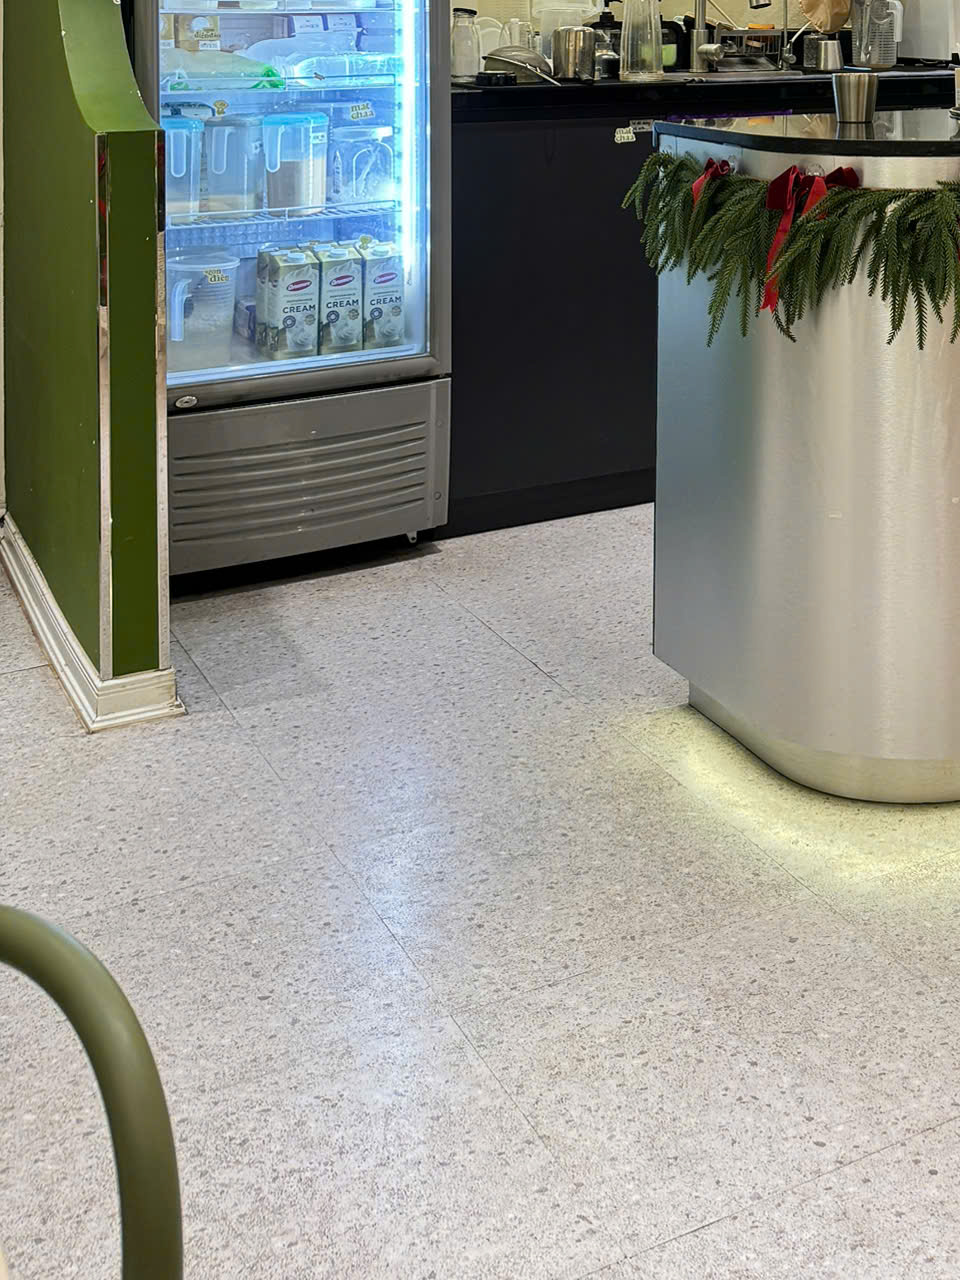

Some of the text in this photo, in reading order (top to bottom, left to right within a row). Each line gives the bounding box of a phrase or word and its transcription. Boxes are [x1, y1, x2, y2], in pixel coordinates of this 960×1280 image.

[326, 299, 359, 309] CREAM
[370, 296, 402, 306] CREAM
[283, 304, 316, 313] CREAM
